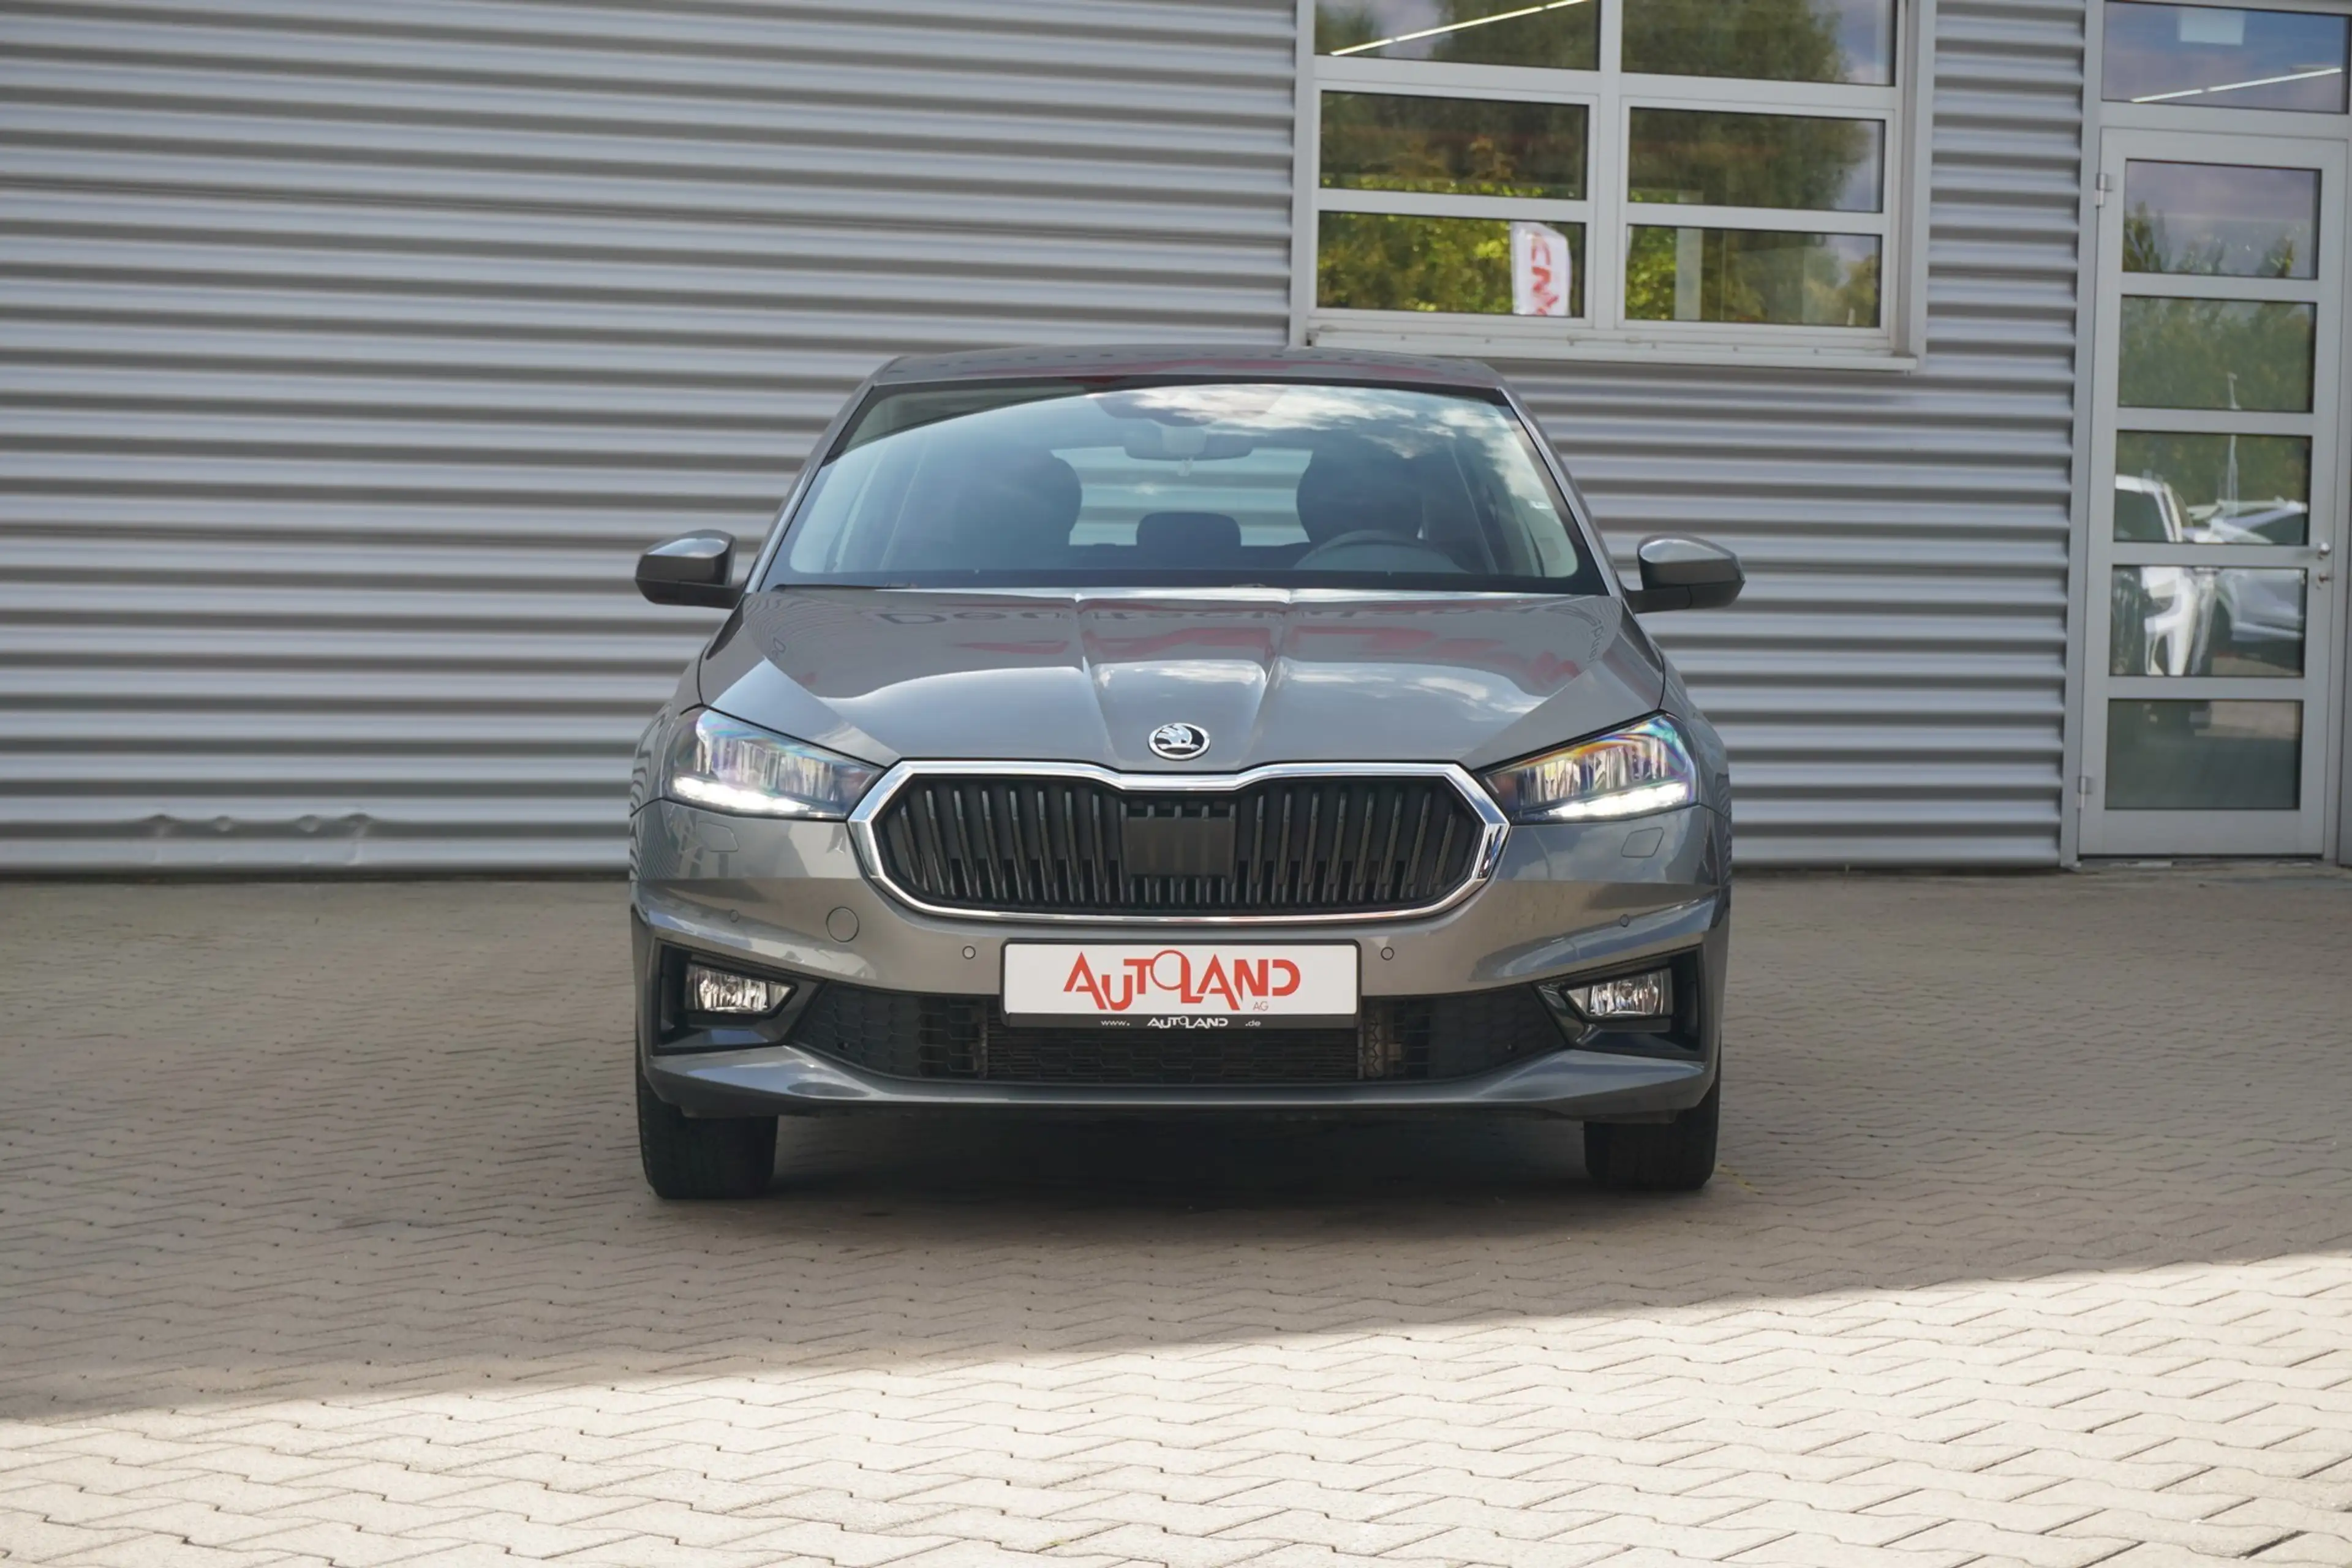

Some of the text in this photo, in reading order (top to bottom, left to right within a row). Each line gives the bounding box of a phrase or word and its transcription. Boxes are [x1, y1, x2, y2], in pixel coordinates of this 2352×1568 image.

[1063, 949, 1301, 1011] AUTOLAND
[1253, 1001, 1269, 1011] AG
[1147, 1016, 1229, 1029] AUTOLAND
